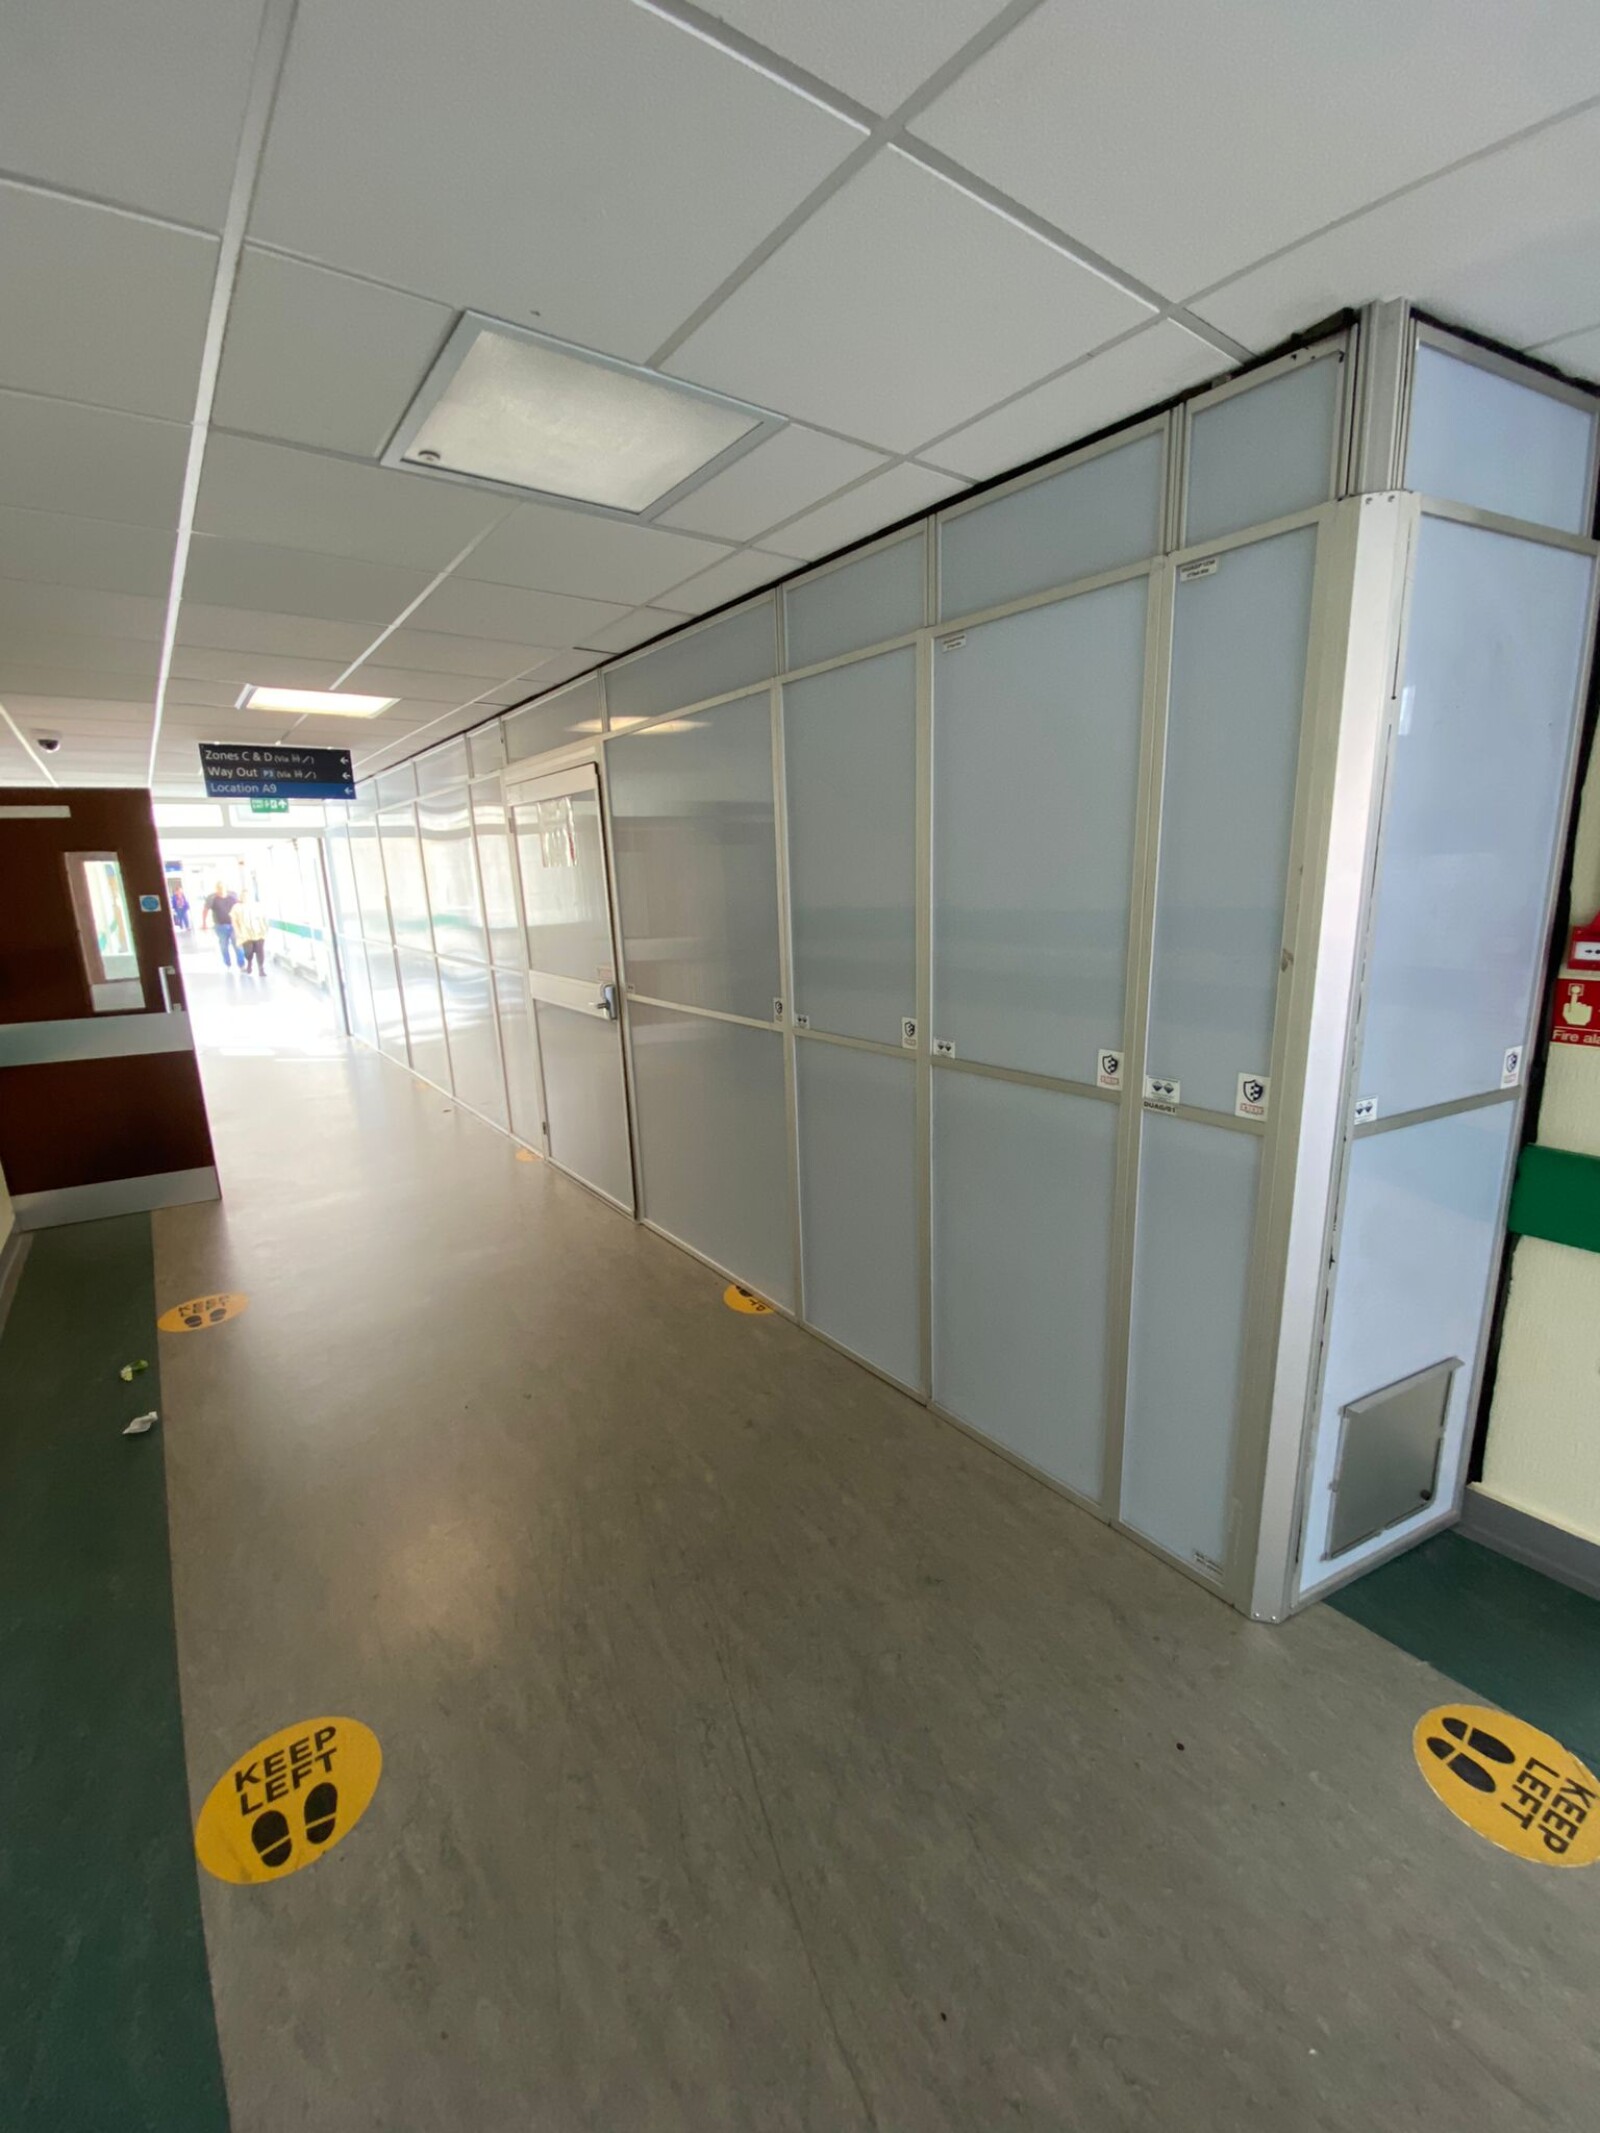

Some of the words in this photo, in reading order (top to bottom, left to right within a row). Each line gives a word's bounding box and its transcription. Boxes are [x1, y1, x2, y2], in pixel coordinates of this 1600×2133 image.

[205, 750, 239, 761] Zones
[242, 751, 251, 761] C
[252, 752, 261, 762] &
[264, 752, 273, 762] D
[207, 767, 233, 779] Way
[236, 767, 258, 777] Out
[210, 783, 259, 793] Location
[262, 784, 277, 794] A9
[1553, 1030, 1579, 1042] Fire
[234, 1726, 337, 1793] KEEP
[240, 1747, 337, 1816] LEFT
[1500, 1756, 1560, 1831] LEFT
[1537, 1777, 1597, 1854] KEEP
